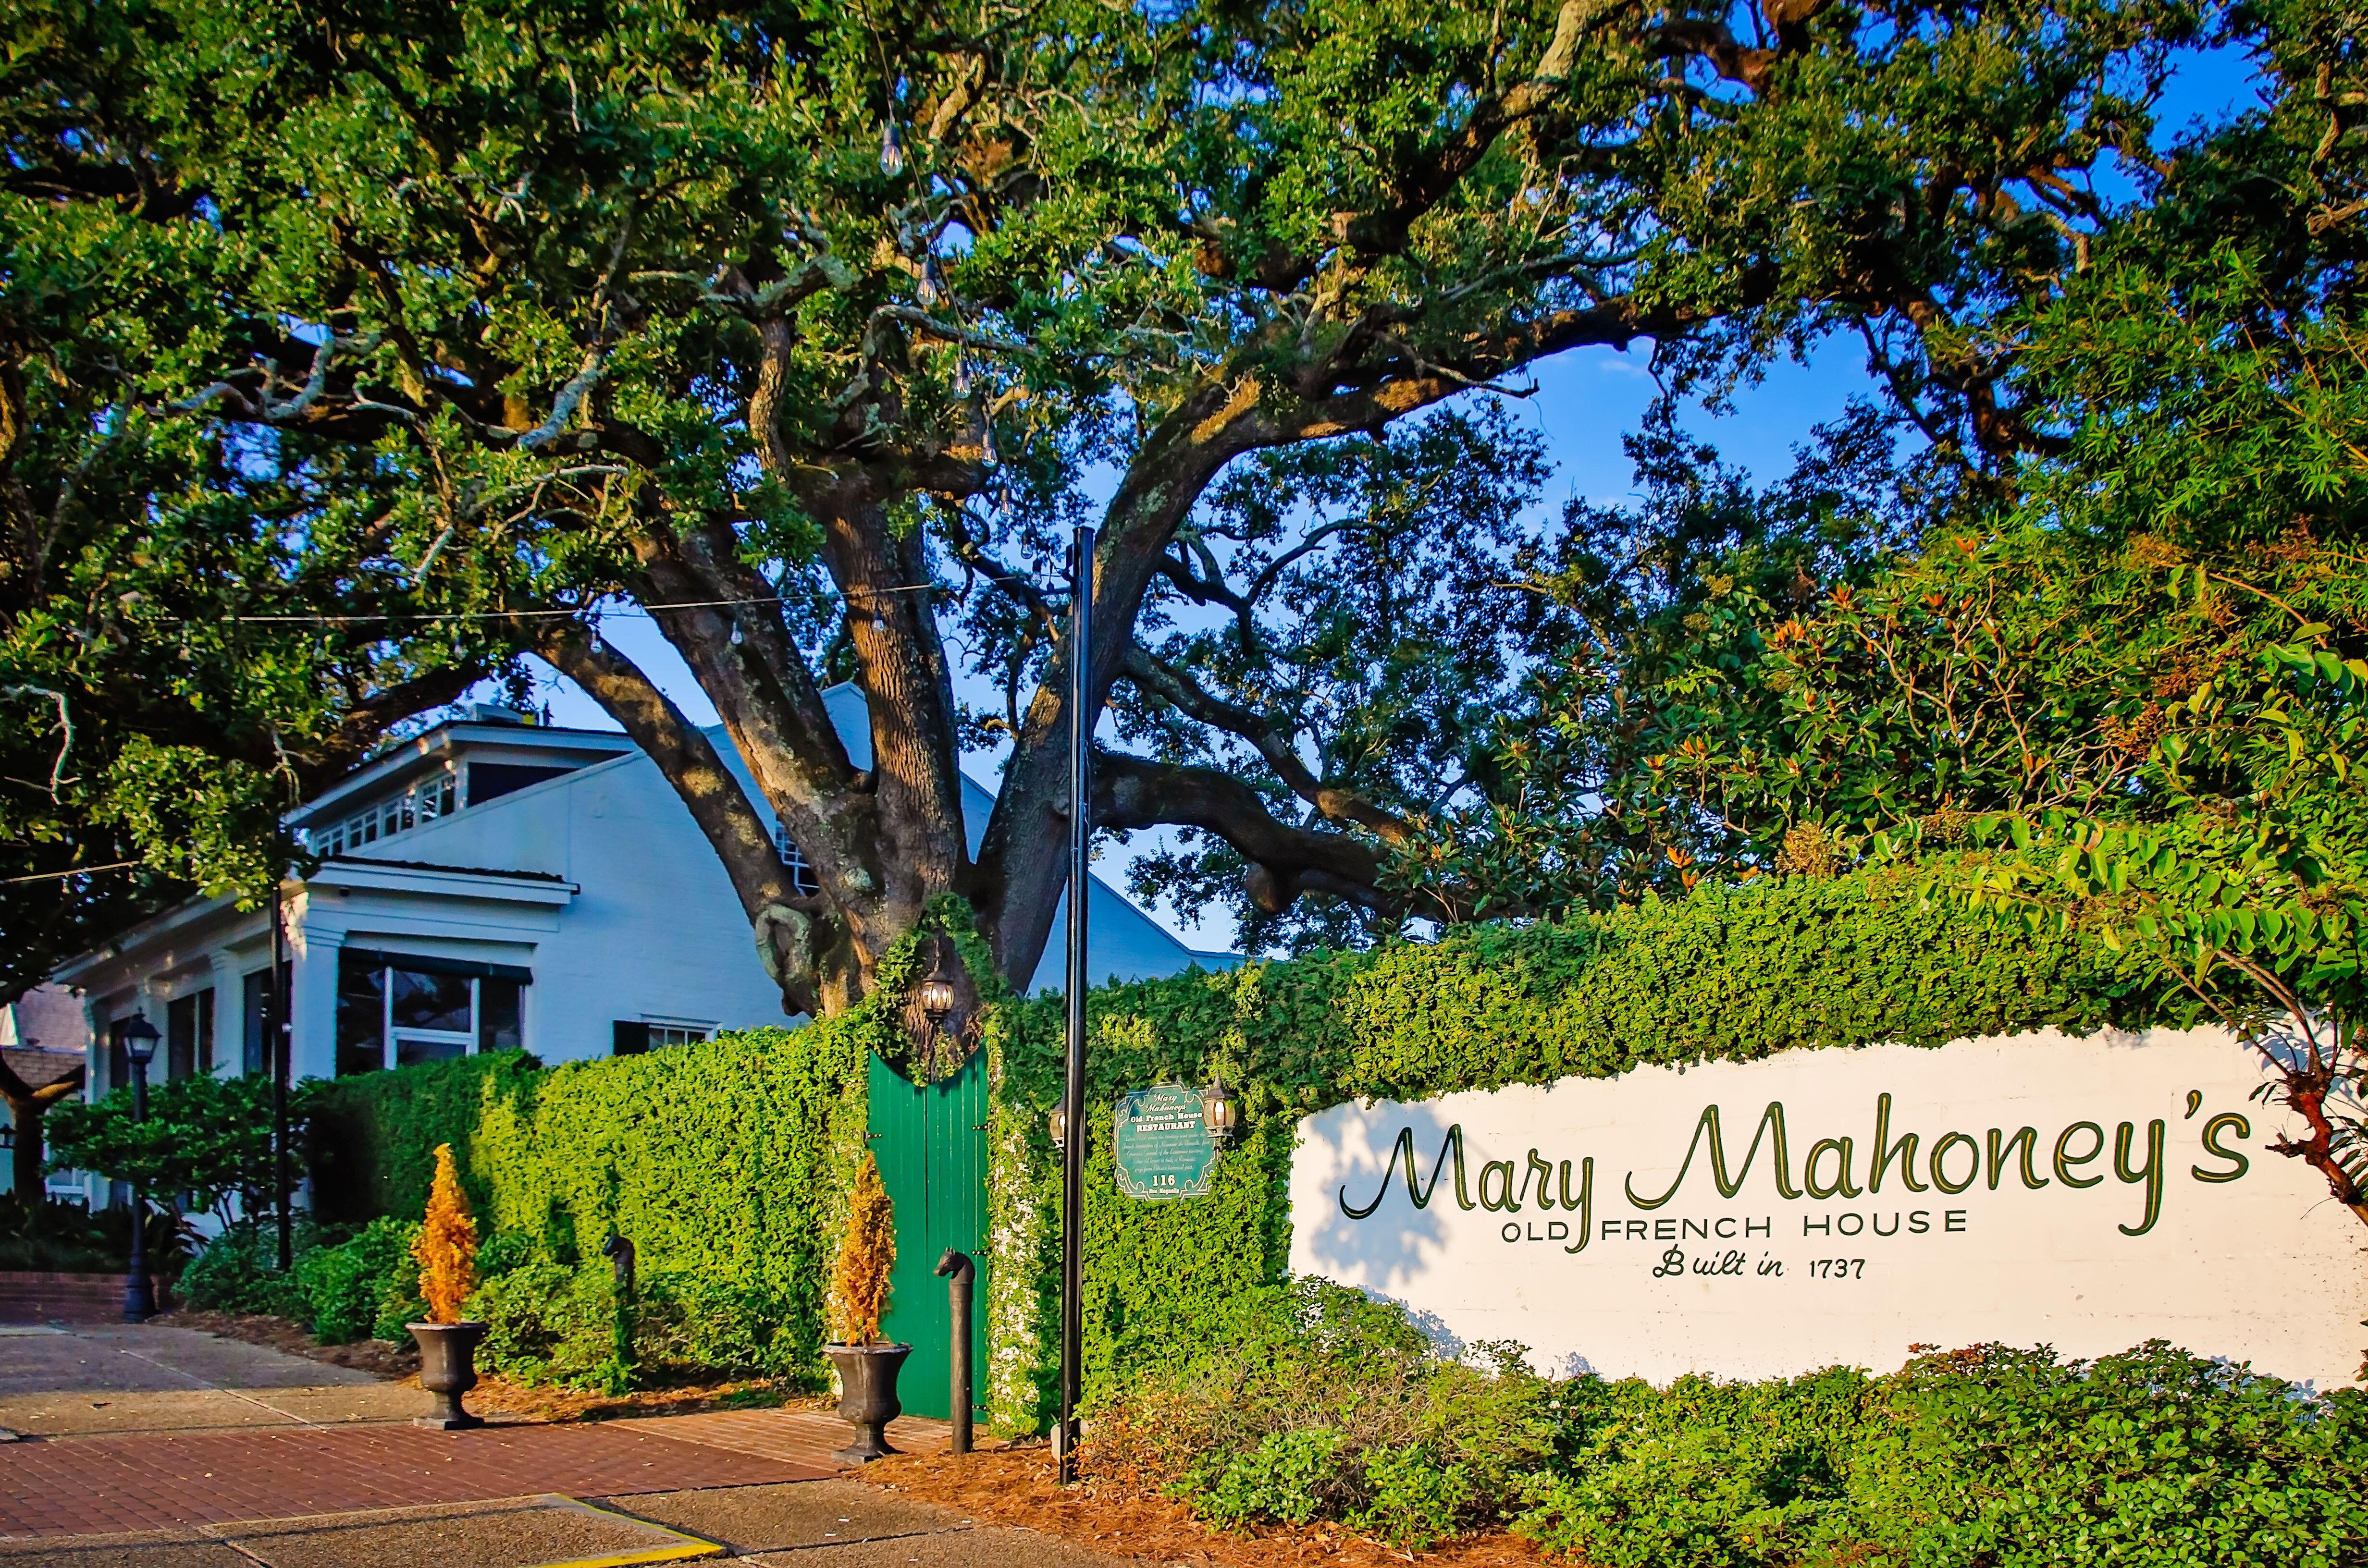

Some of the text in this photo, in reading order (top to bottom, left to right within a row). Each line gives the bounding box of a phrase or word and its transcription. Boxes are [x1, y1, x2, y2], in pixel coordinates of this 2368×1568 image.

[1153, 1092, 1178, 1104] Mary
[1146, 1113, 1174, 1122] French
[1136, 1121, 1196, 1132] RESTAURANT
[1339, 1090, 2251, 1254] Mary Mahoney's
[1152, 1174, 1175, 1187] 116
[1502, 1210, 1967, 1242] OLD FRENCH HOUSE
[1653, 1243, 1866, 1279] Built in 1737
